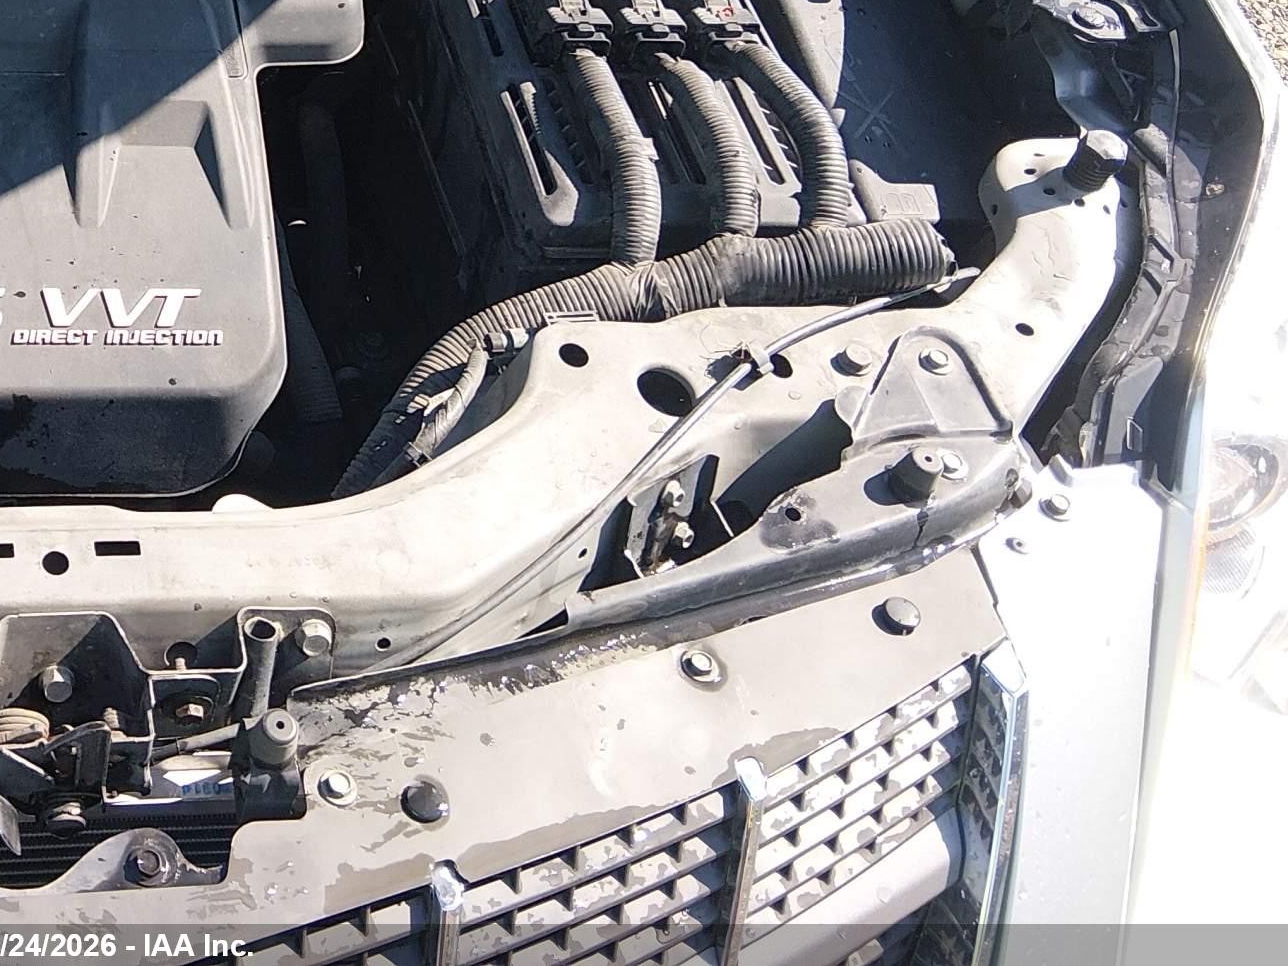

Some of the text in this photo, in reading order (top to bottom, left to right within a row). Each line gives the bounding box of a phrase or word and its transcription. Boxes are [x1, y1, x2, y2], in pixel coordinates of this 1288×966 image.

[39, 287, 203, 329] VVT
[10, 329, 224, 347] DIRECT INJECTION
